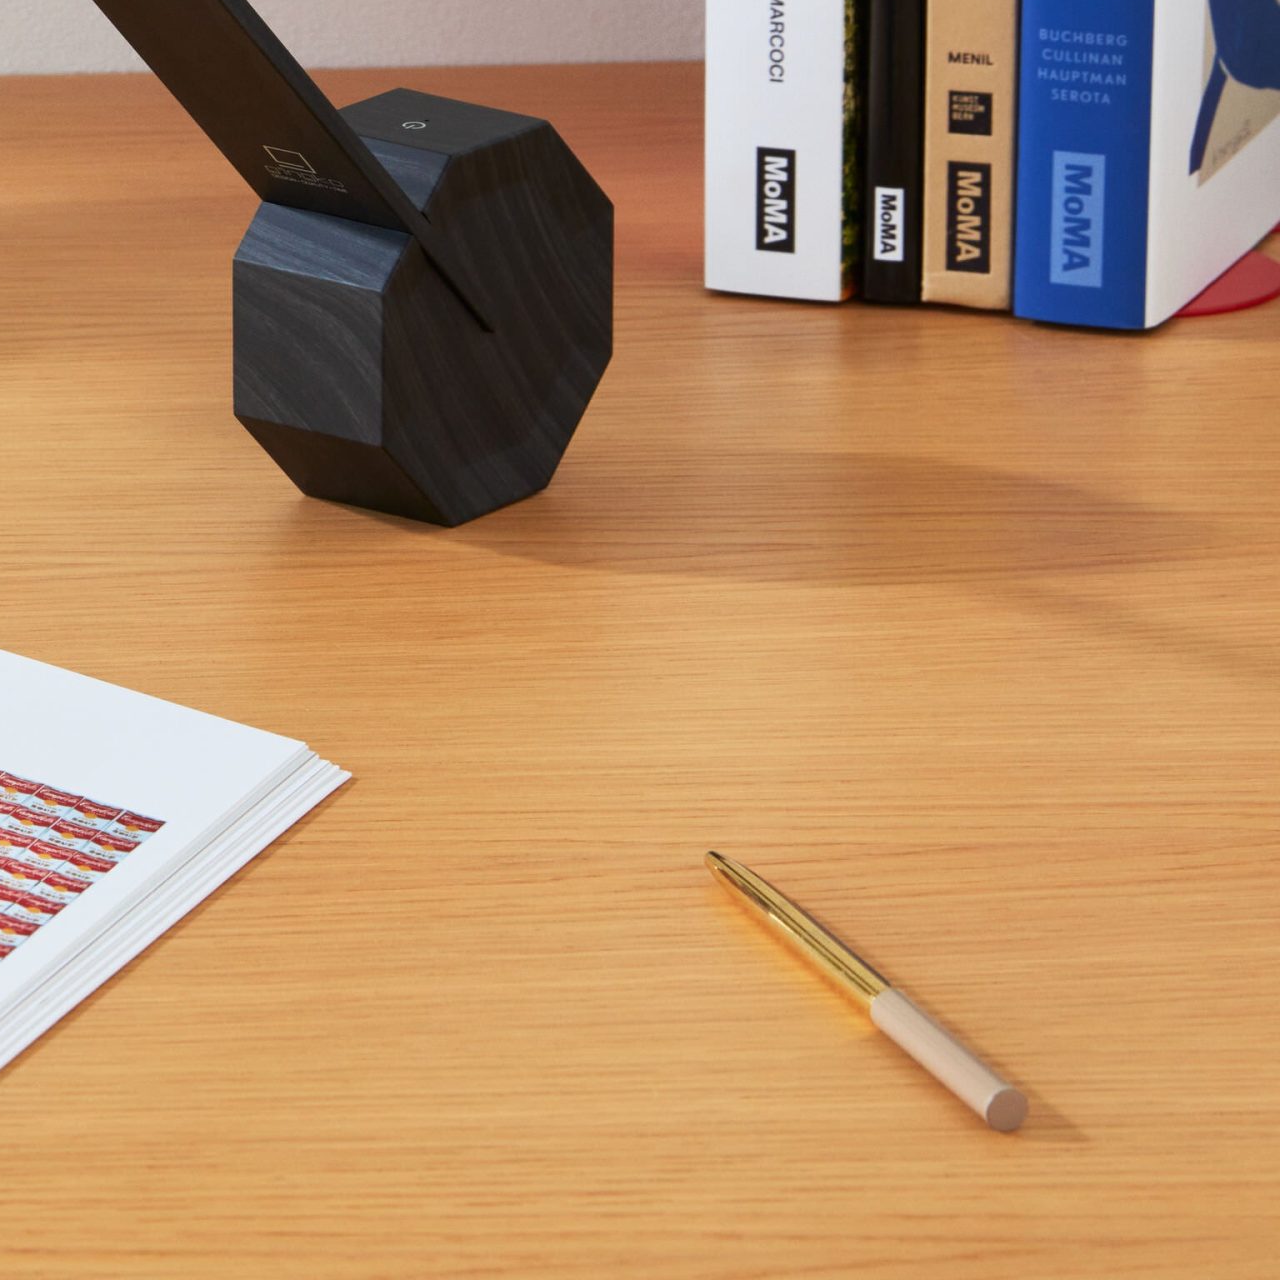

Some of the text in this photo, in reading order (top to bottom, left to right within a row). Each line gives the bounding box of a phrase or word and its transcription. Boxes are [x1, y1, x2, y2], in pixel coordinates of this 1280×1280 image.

[1039, 28, 1128, 47] BUCHBERG
[948, 51, 994, 66] MENIL
[1041, 48, 1123, 66] CULLINAN
[1037, 68, 1127, 86] HAUPTMAN
[952, 94, 980, 103] KUNST
[1051, 88, 1111, 105] SEROTA
[764, 155, 787, 246] MoMA
[880, 193, 897, 256] MoMA
[956, 170, 982, 263] MoMA
[1062, 163, 1093, 272] MoMA
